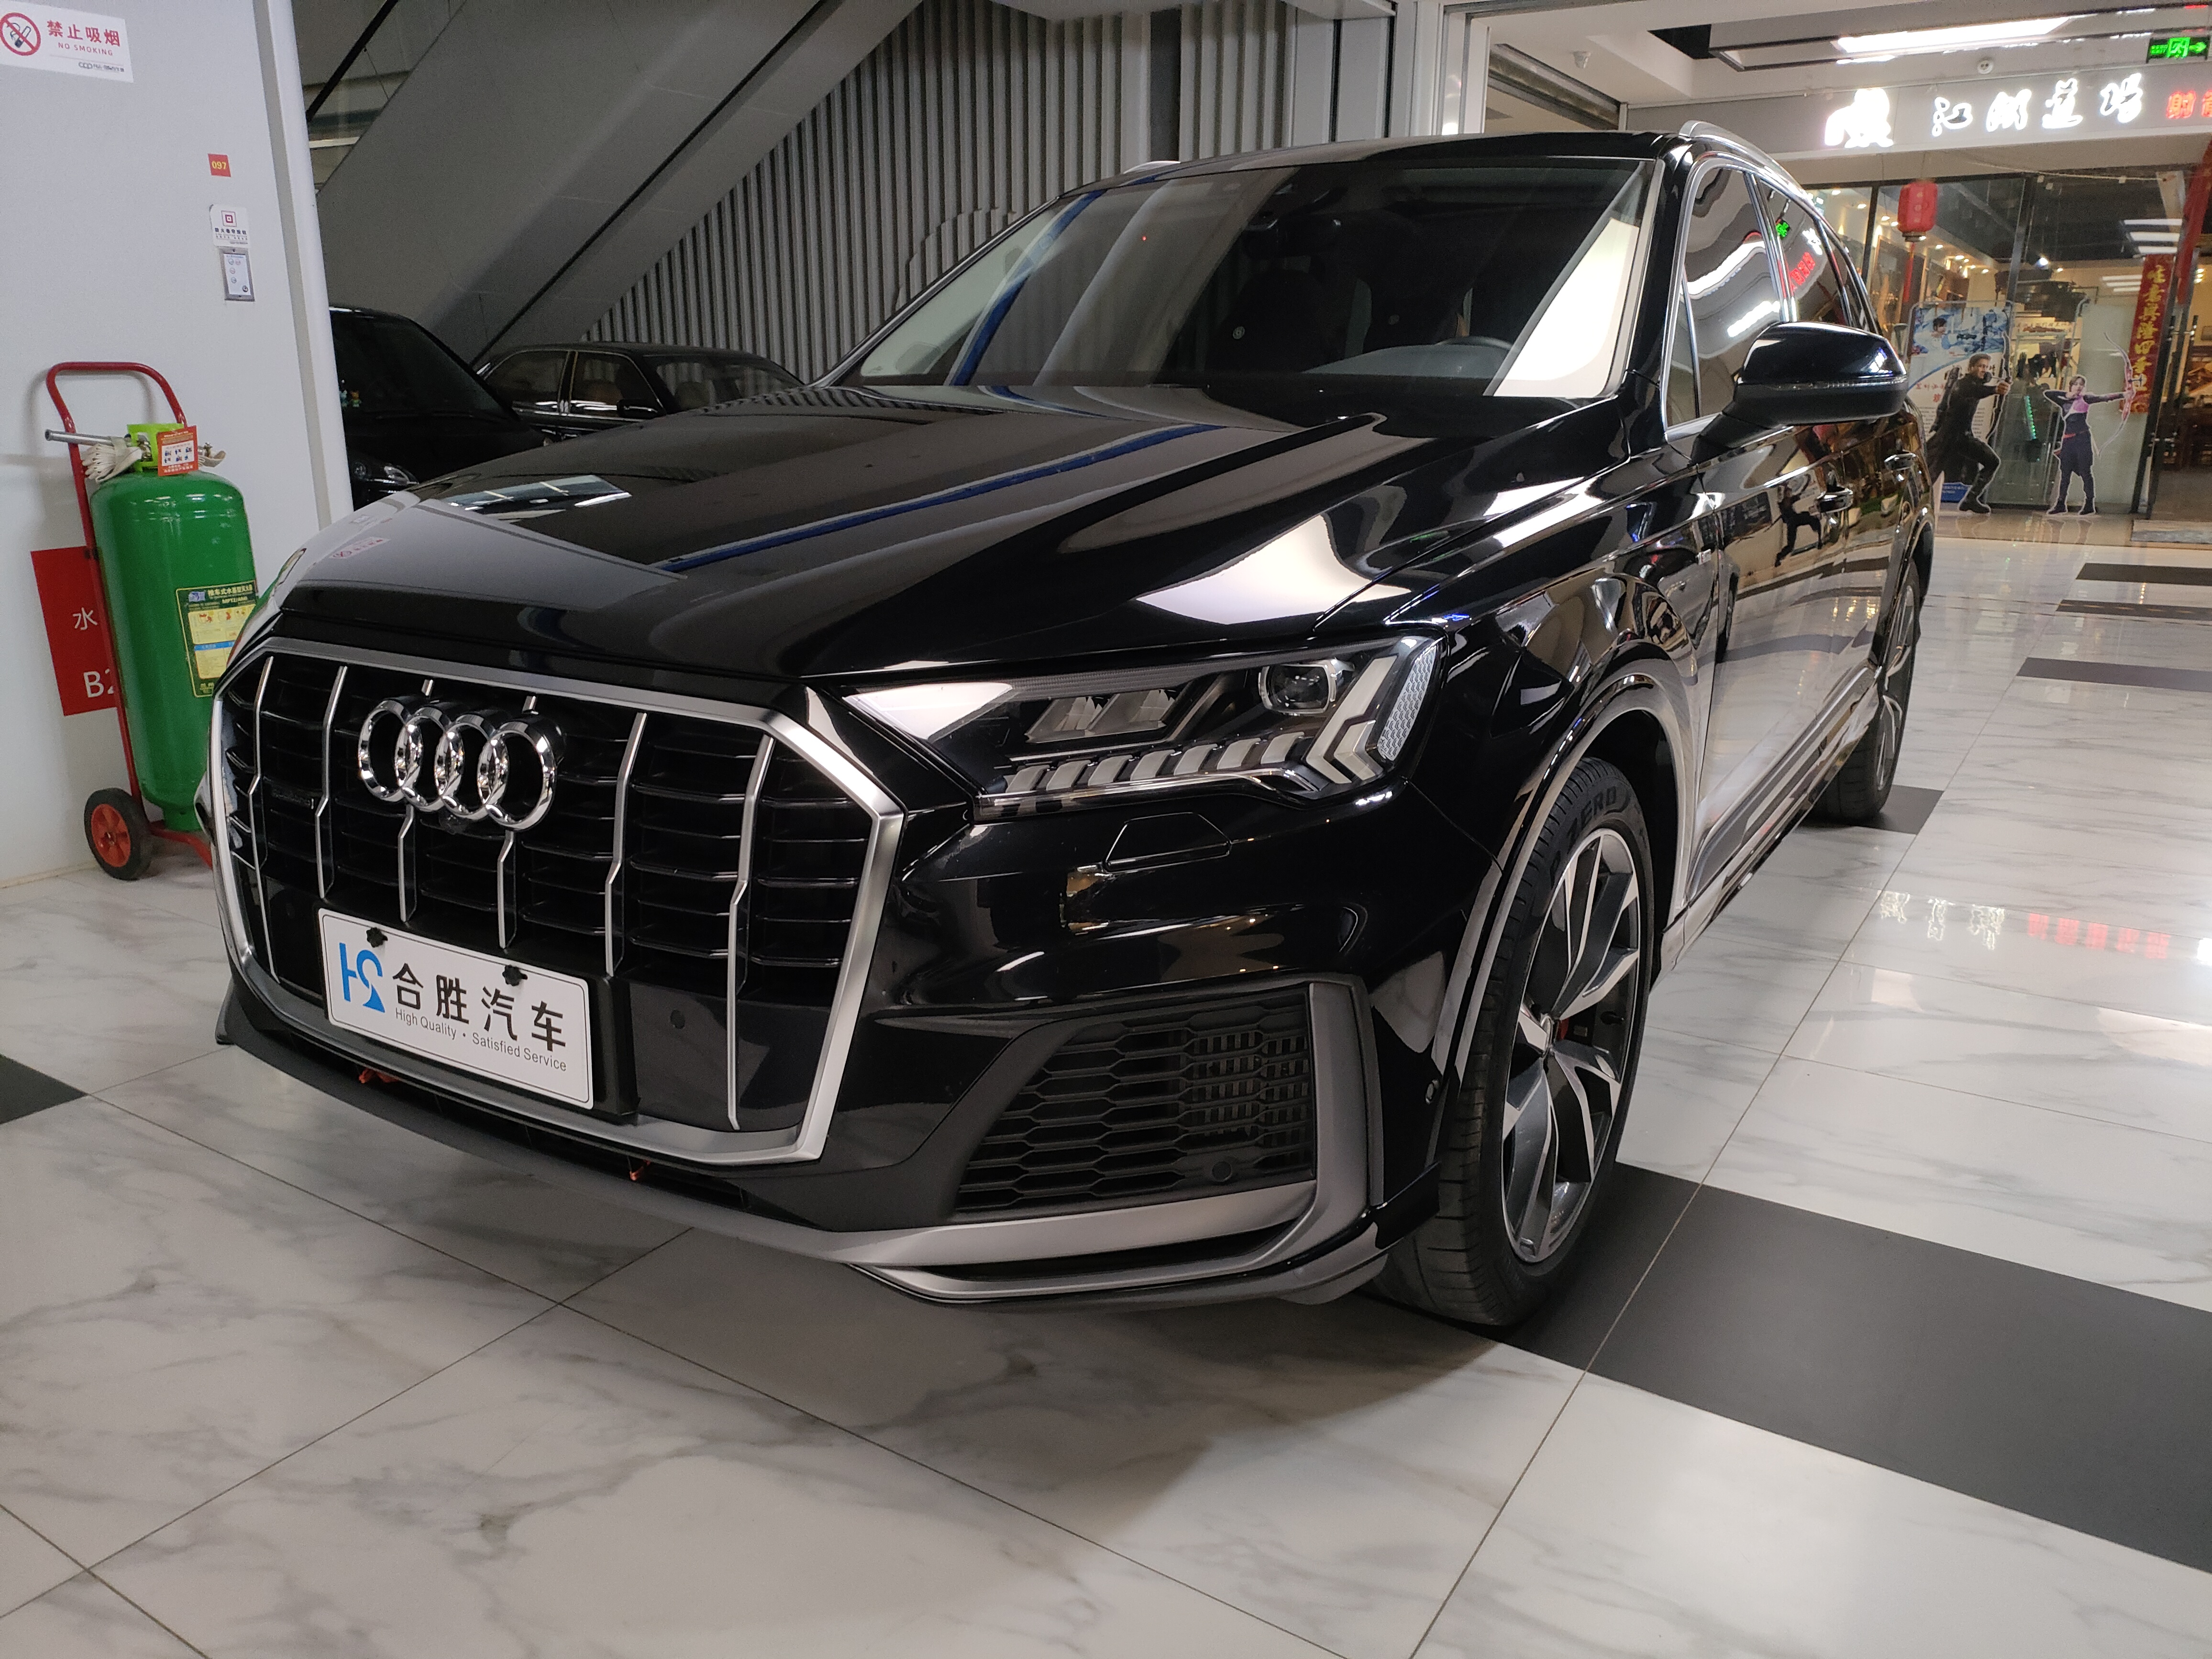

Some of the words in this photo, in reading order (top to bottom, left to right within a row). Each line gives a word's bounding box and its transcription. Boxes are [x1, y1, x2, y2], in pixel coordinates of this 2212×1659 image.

[47, 20, 120, 47] 禁止吸烟
[74, 44, 113, 56] SMOKING
[211, 160, 227, 170] 097
[72, 607, 98, 630] 水
[392, 962, 566, 1051] 合胜汽车
[396, 1007, 418, 1026] High
[420, 1016, 457, 1040] Quality
[472, 1032, 520, 1058] Satisfied
[523, 1047, 567, 1072] Service
